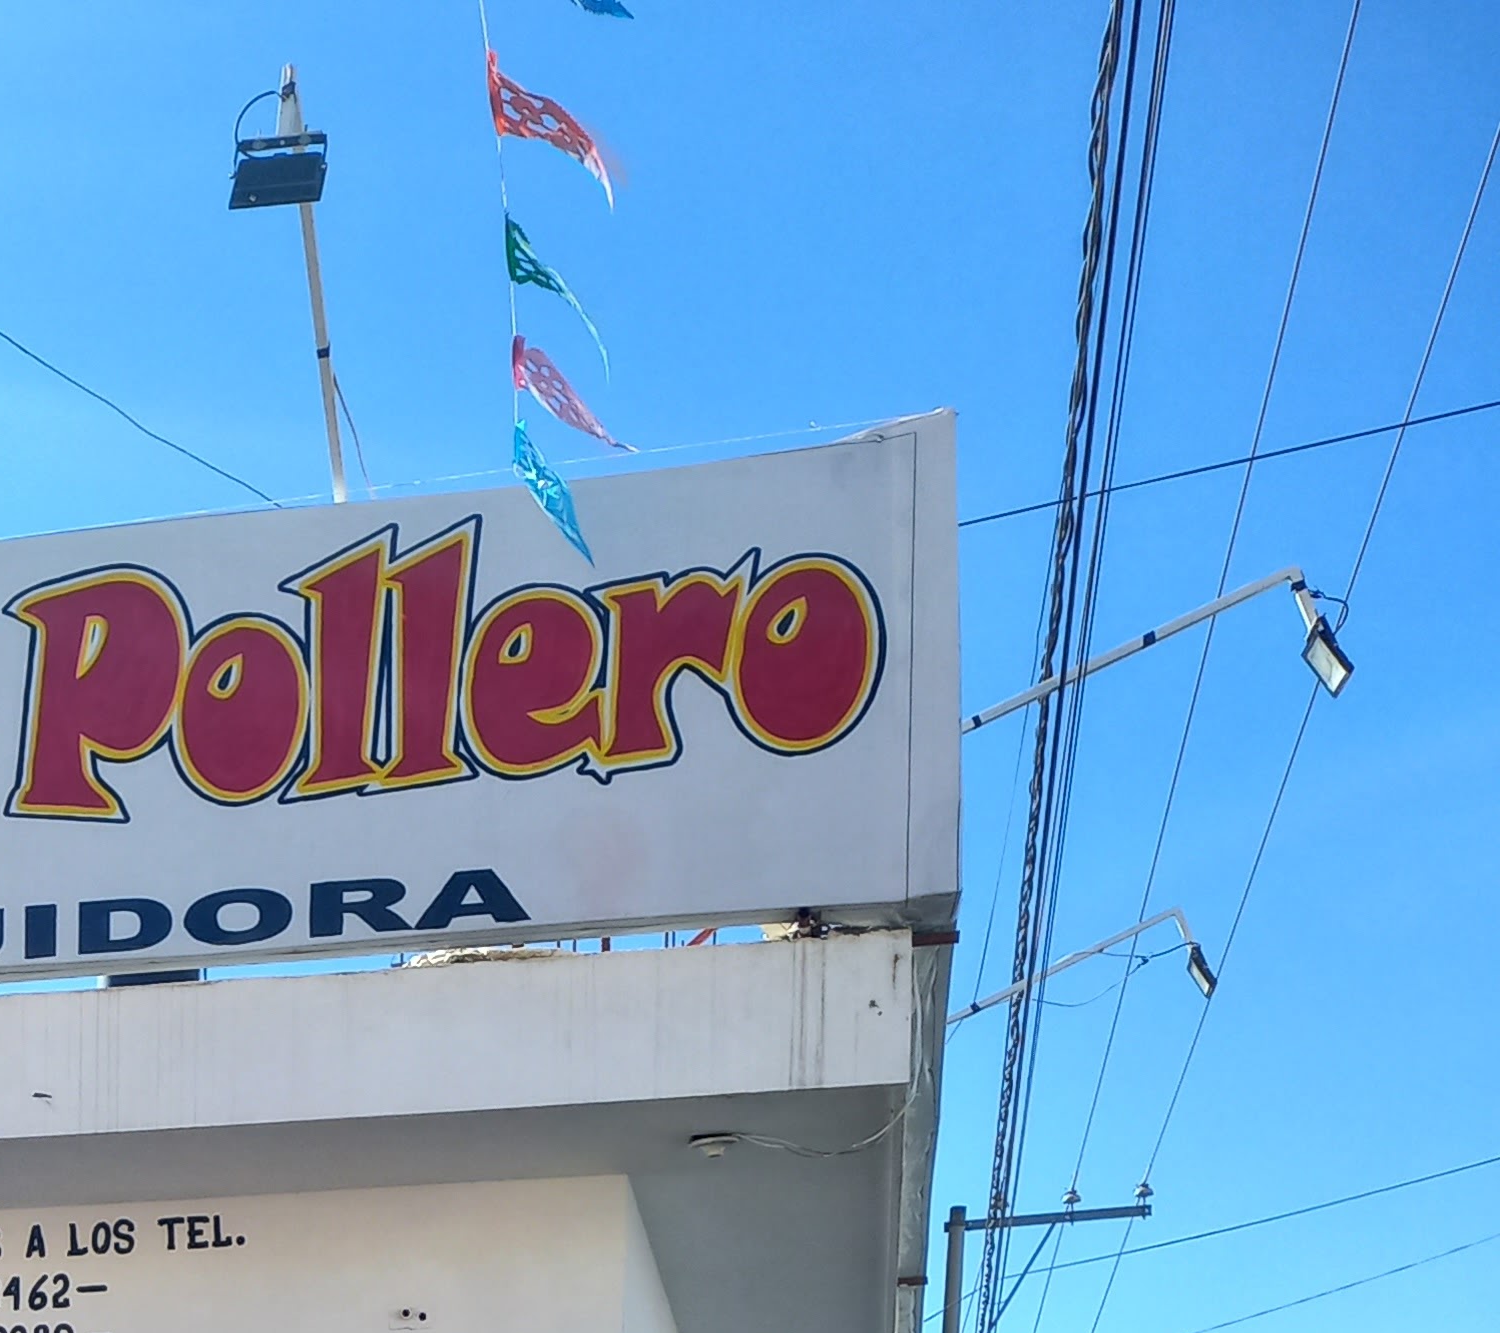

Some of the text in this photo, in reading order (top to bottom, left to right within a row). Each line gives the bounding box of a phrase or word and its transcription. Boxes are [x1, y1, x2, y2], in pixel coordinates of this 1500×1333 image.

[2, 513, 885, 824] Pollero
[26, 1226, 46, 1258] A
[67, 1221, 135, 1256] LOS
[158, 1215, 246, 1251] TEL.
